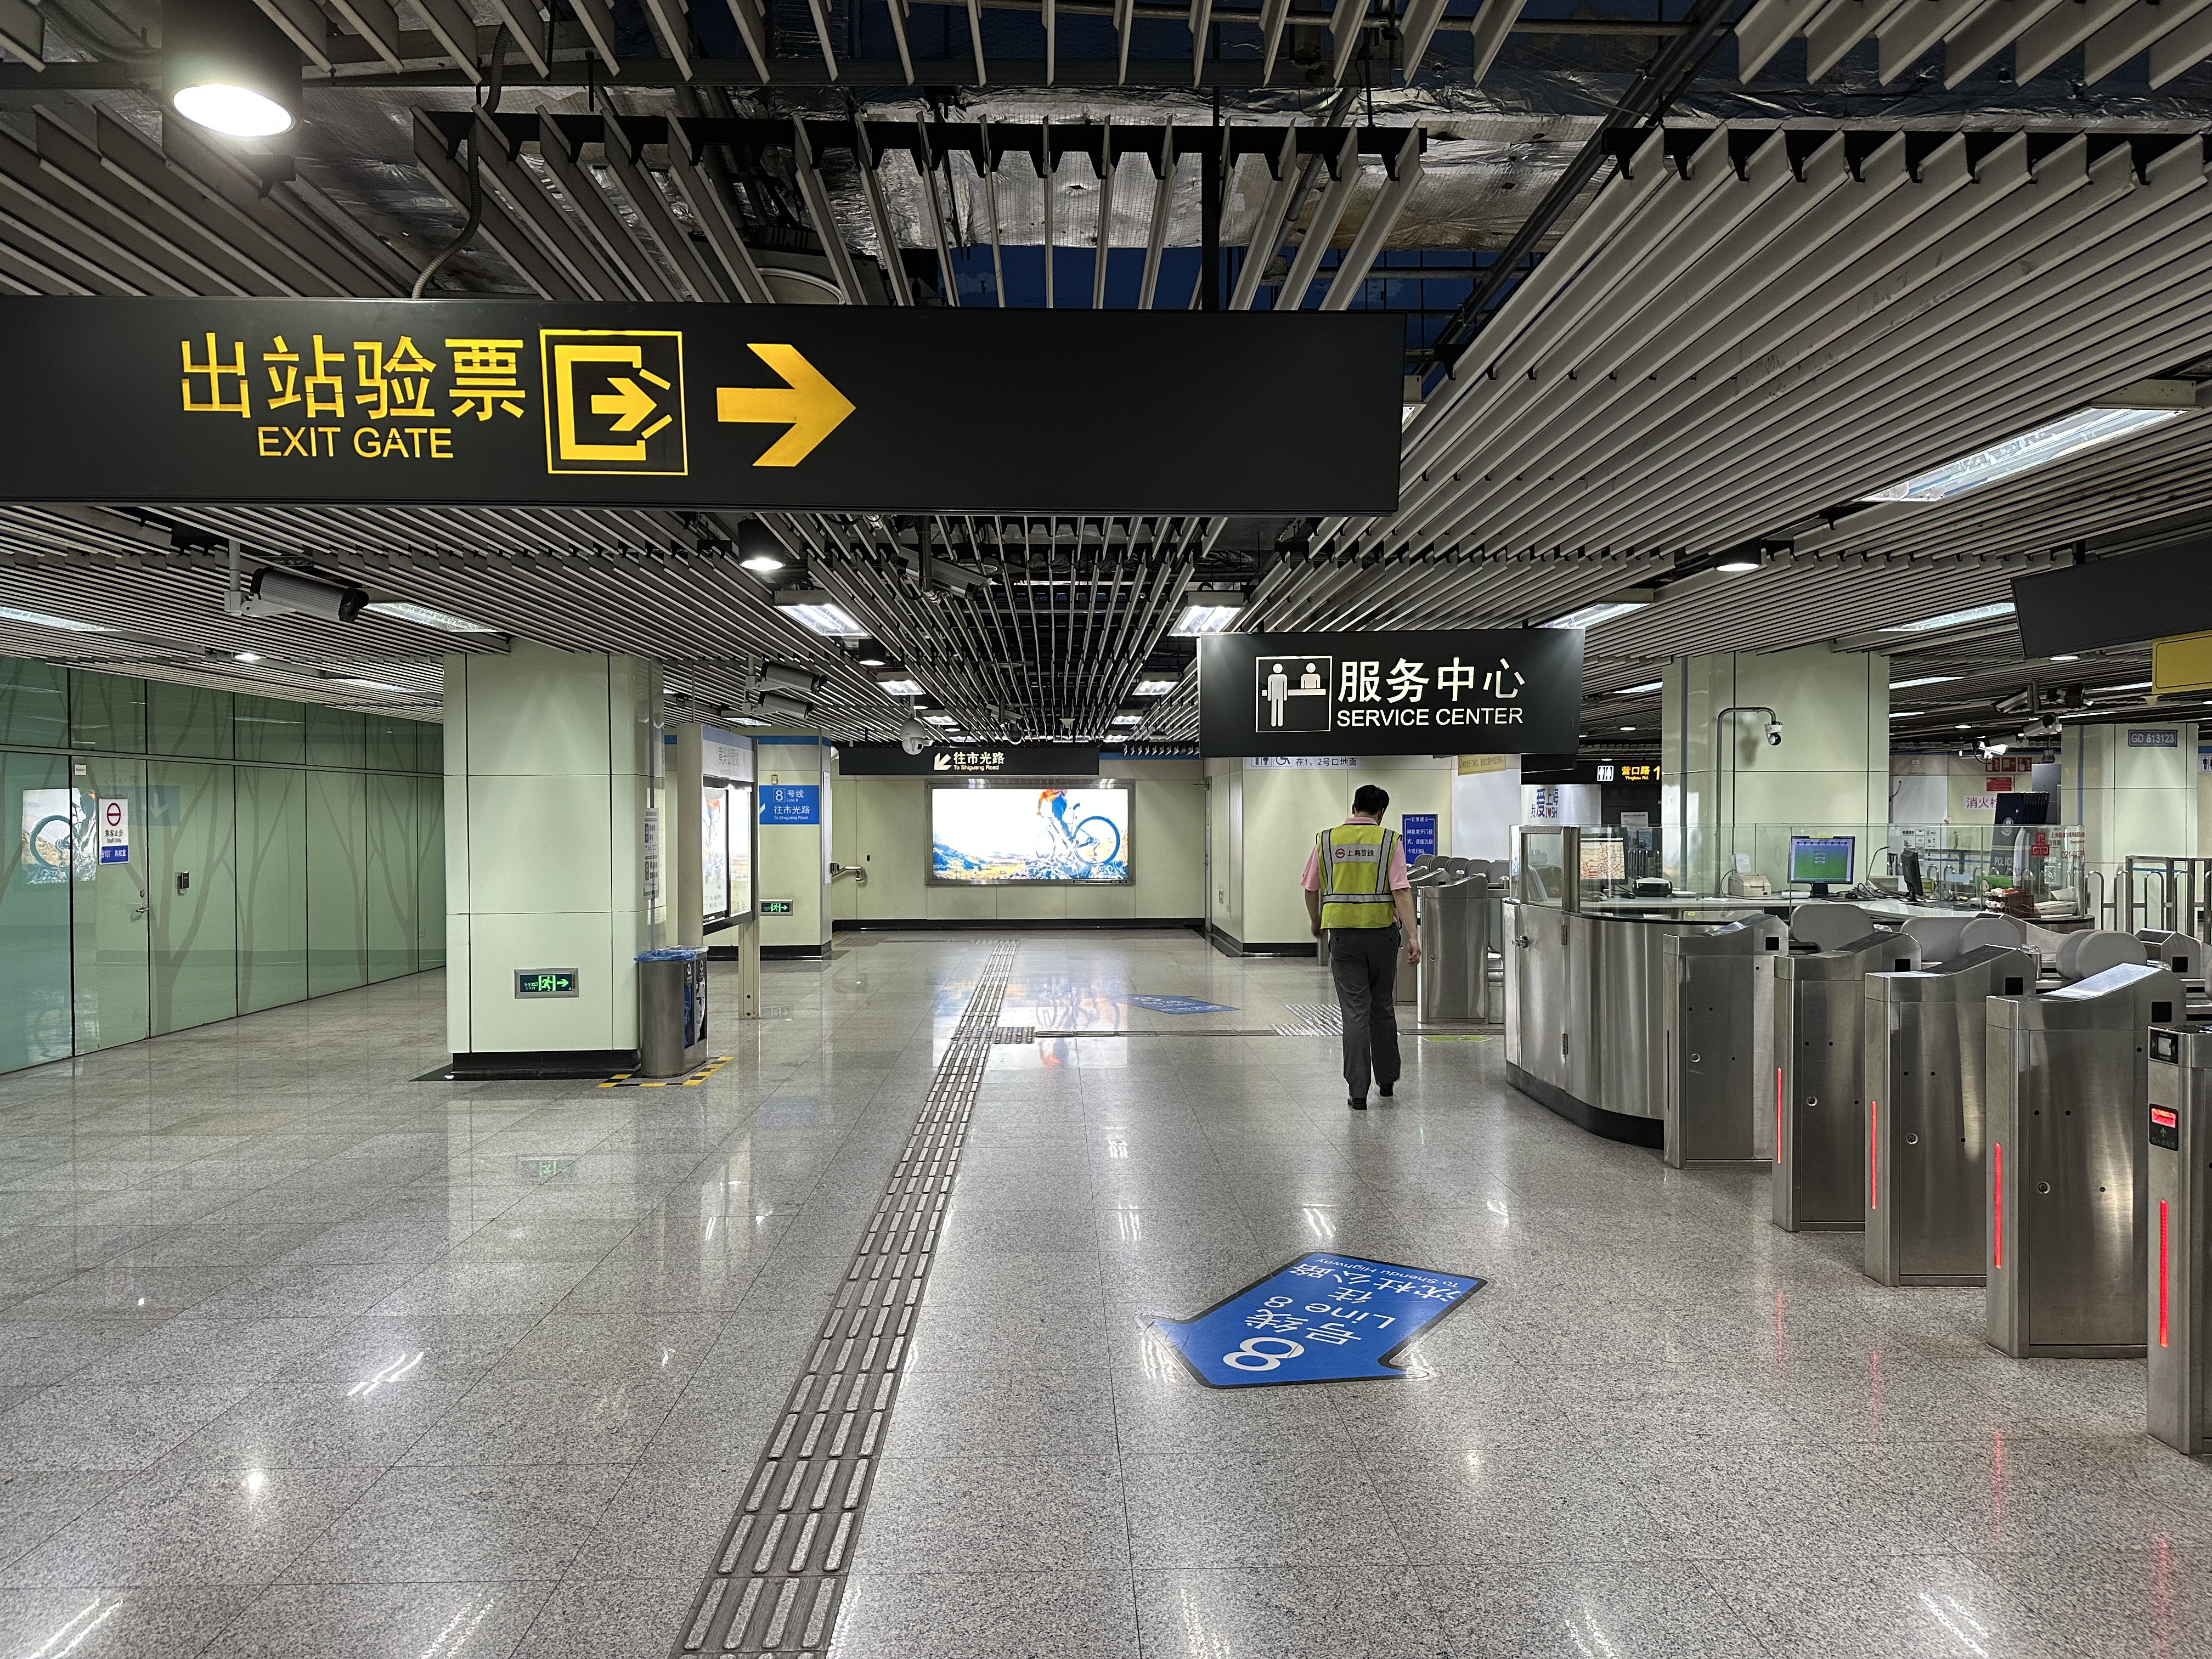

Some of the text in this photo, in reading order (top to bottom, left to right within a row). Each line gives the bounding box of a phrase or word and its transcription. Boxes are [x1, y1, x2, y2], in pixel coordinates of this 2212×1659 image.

[181, 332, 526, 421] 出站验票
[257, 426, 454, 459] EXIT GATE
[1338, 657, 1526, 703] 服务中心
[1337, 707, 1523, 727] SERVICE CENTER
[2131, 733, 2174, 743] GD 813123
[953, 751, 1005, 765] 往市光路
[1295, 757, 1357, 766] 在1、2号口地面
[1621, 766, 1650, 776] 营口路
[775, 790, 783, 801] 8
[787, 789, 804, 798] 号线
[774, 805, 810, 814] 往市光路
[1289, 1263, 1462, 1302] 沈杜公路
[1315, 1259, 1459, 1289] To Shendu Highway
[1327, 1286, 1373, 1304] 往
[1263, 1296, 1397, 1329] Line 8
[1244, 1308, 1362, 1345] 号线
[1223, 1336, 1305, 1372] 8
